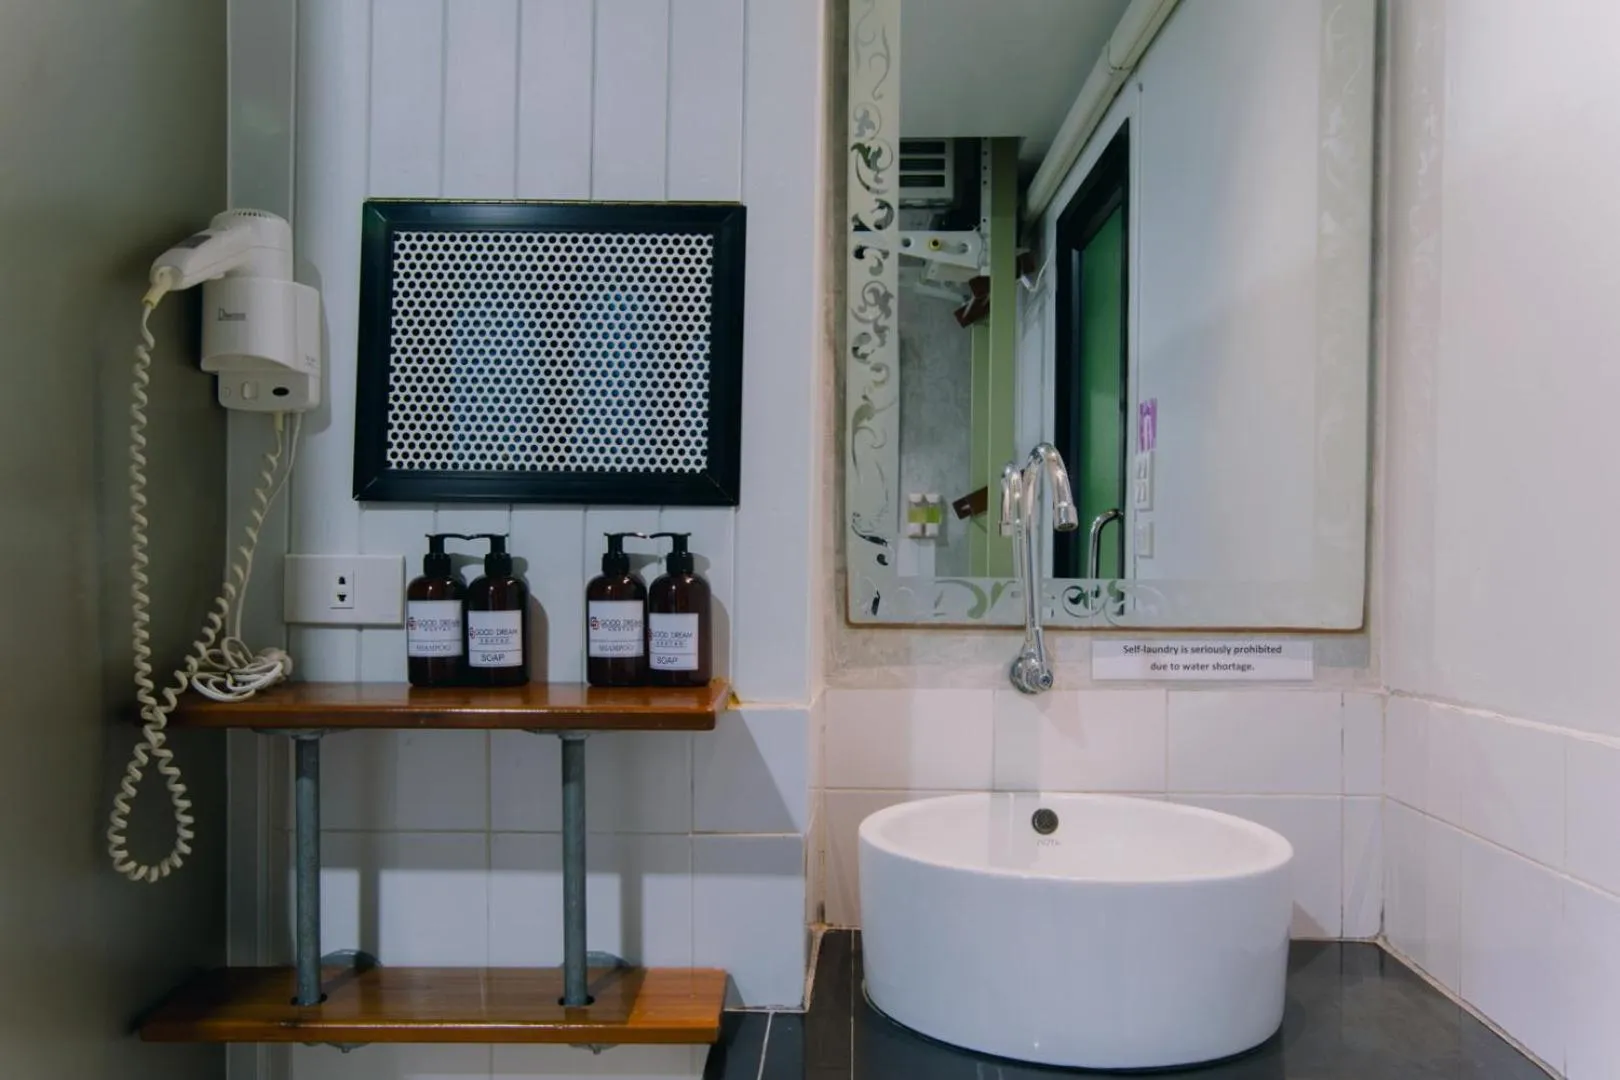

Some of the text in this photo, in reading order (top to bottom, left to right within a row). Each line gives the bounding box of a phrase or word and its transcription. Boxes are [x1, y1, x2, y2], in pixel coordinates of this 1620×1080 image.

[1122, 644, 1282, 655] Self-laundry is seriously prohibited
[480, 653, 505, 663] SOAP
[656, 655, 679, 665] SOAP
[1150, 661, 1255, 673] due to water shortage.
